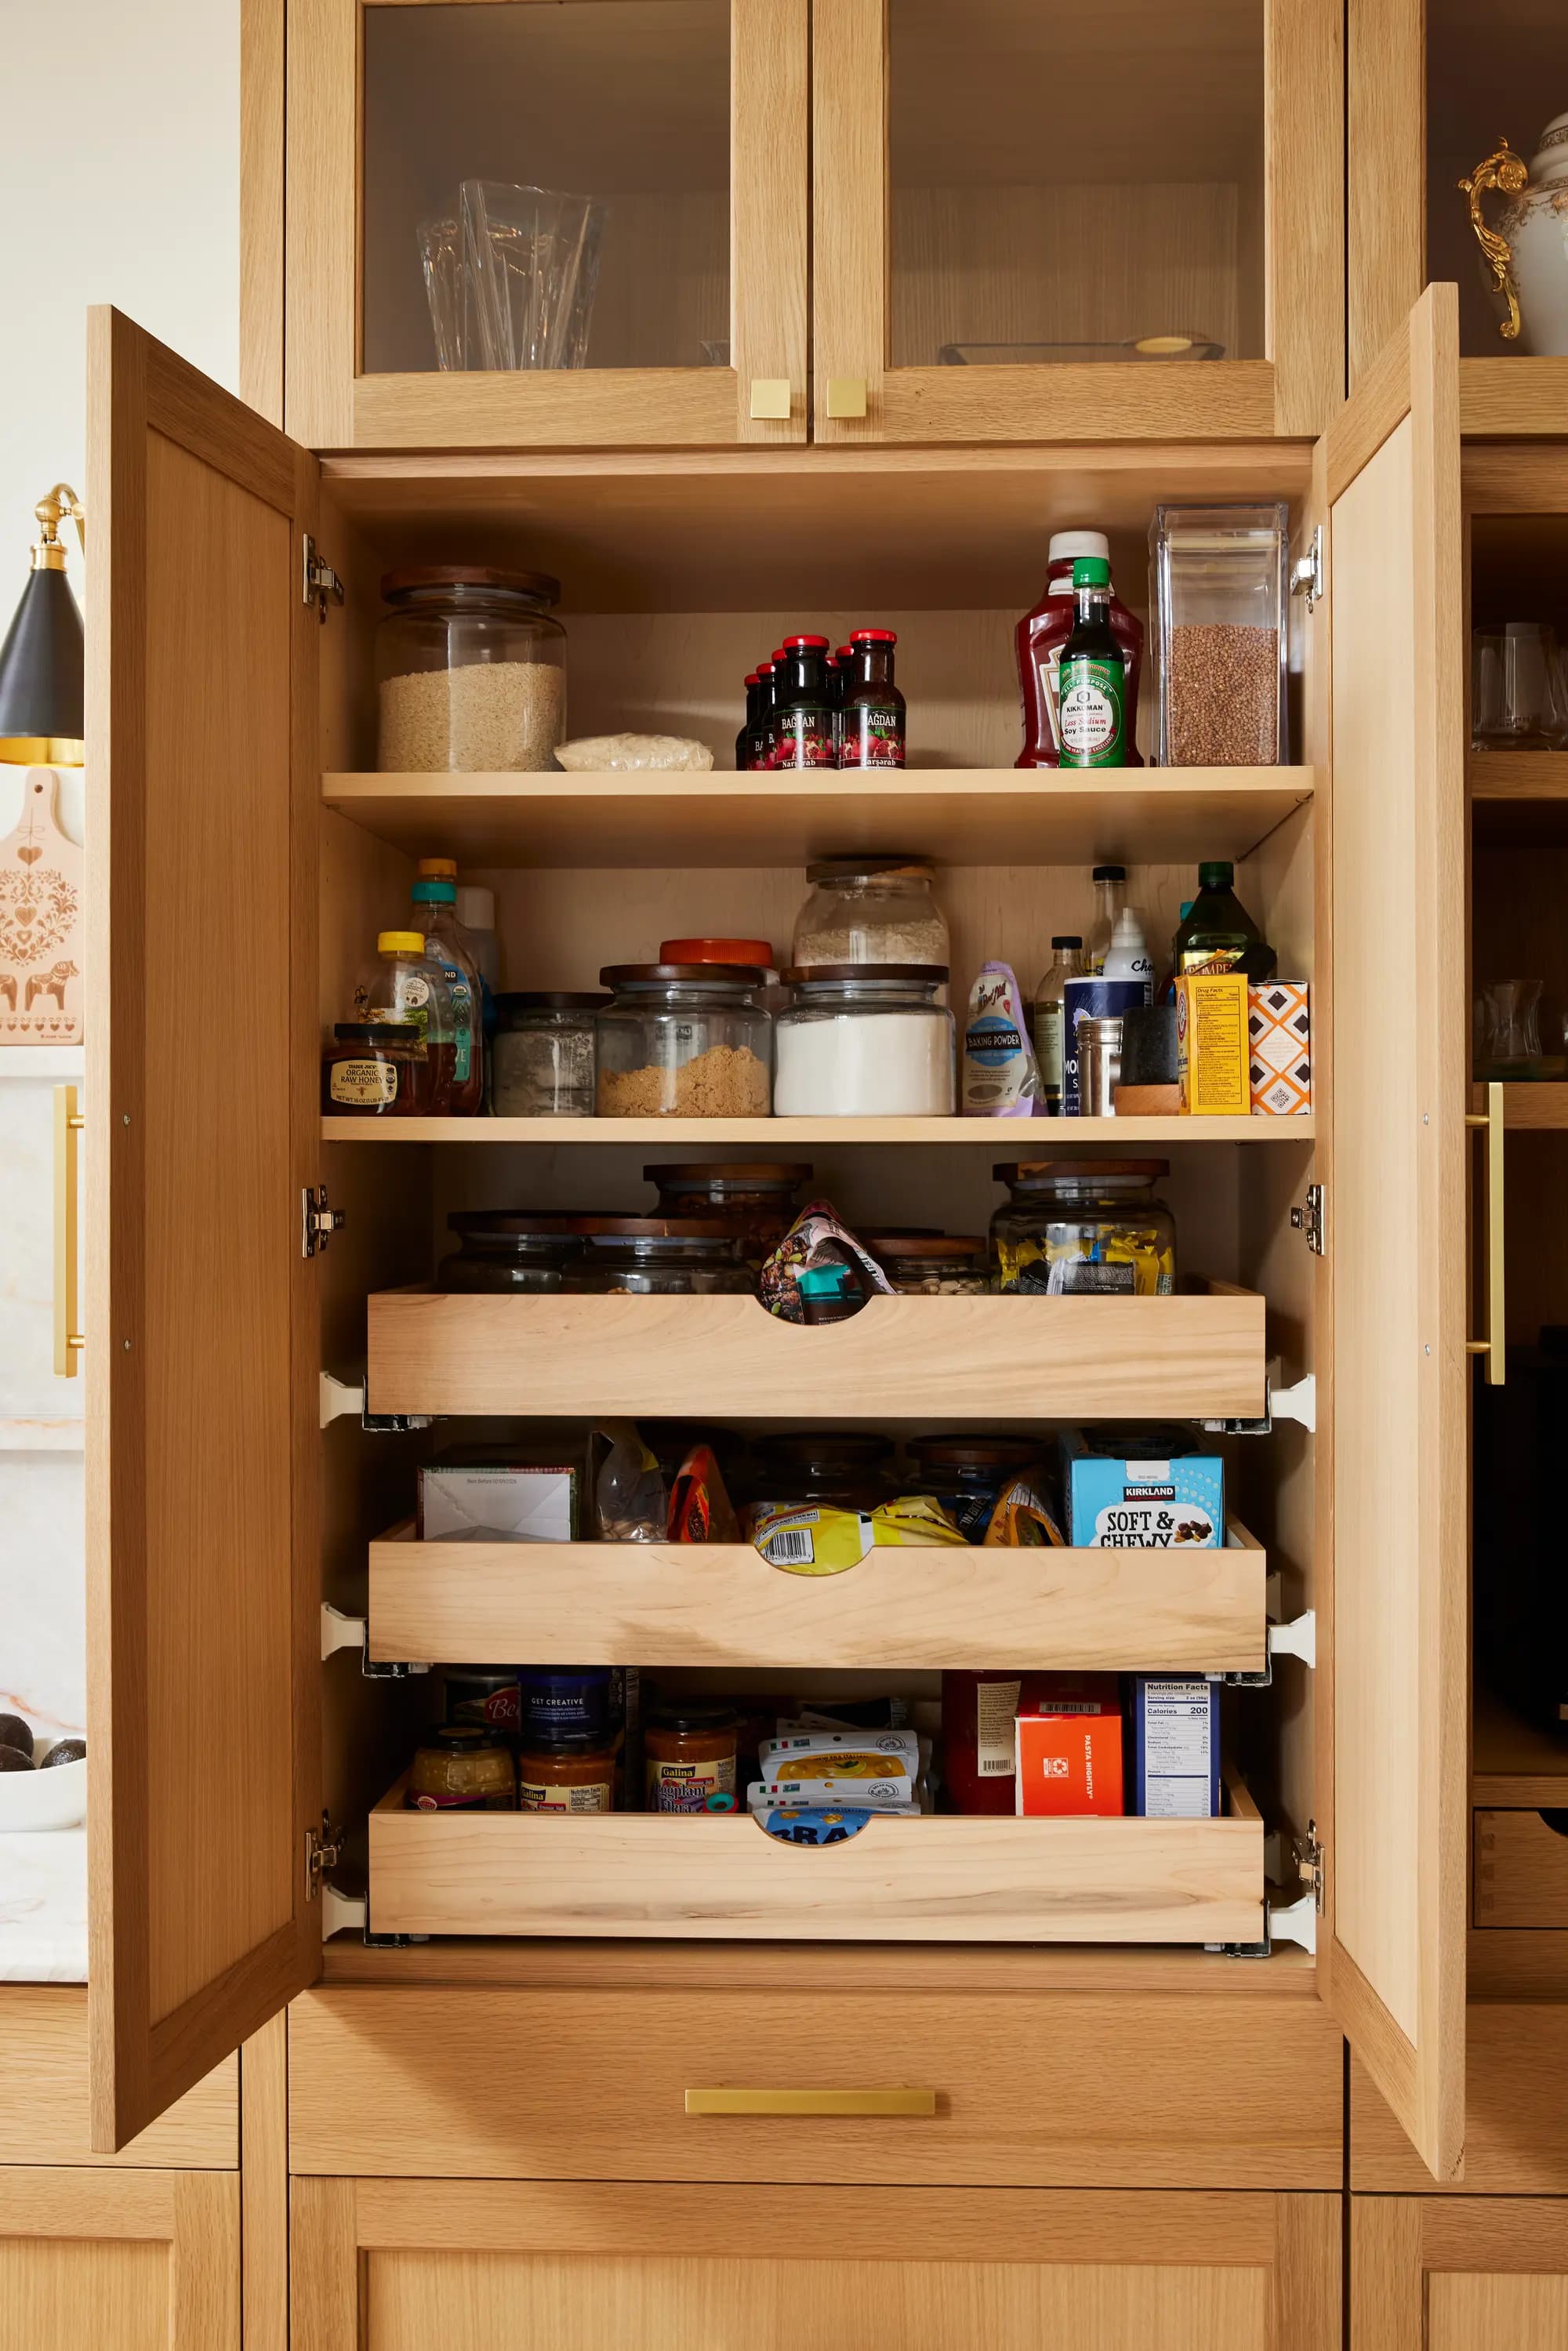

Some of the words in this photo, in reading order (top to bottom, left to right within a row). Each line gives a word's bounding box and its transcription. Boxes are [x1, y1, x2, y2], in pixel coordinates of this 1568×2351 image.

[967, 1036, 993, 1047] BAKING
[993, 1034, 1020, 1046] POWDER
[346, 1068, 380, 1077] ORGANIC
[1126, 1486, 1173, 1497] KIRKLAND
[1107, 1511, 1152, 1533] SOFT
[1156, 1511, 1175, 1530] &
[1101, 1533, 1173, 1547] CHEWY
[662, 1768, 694, 1777] Galina
